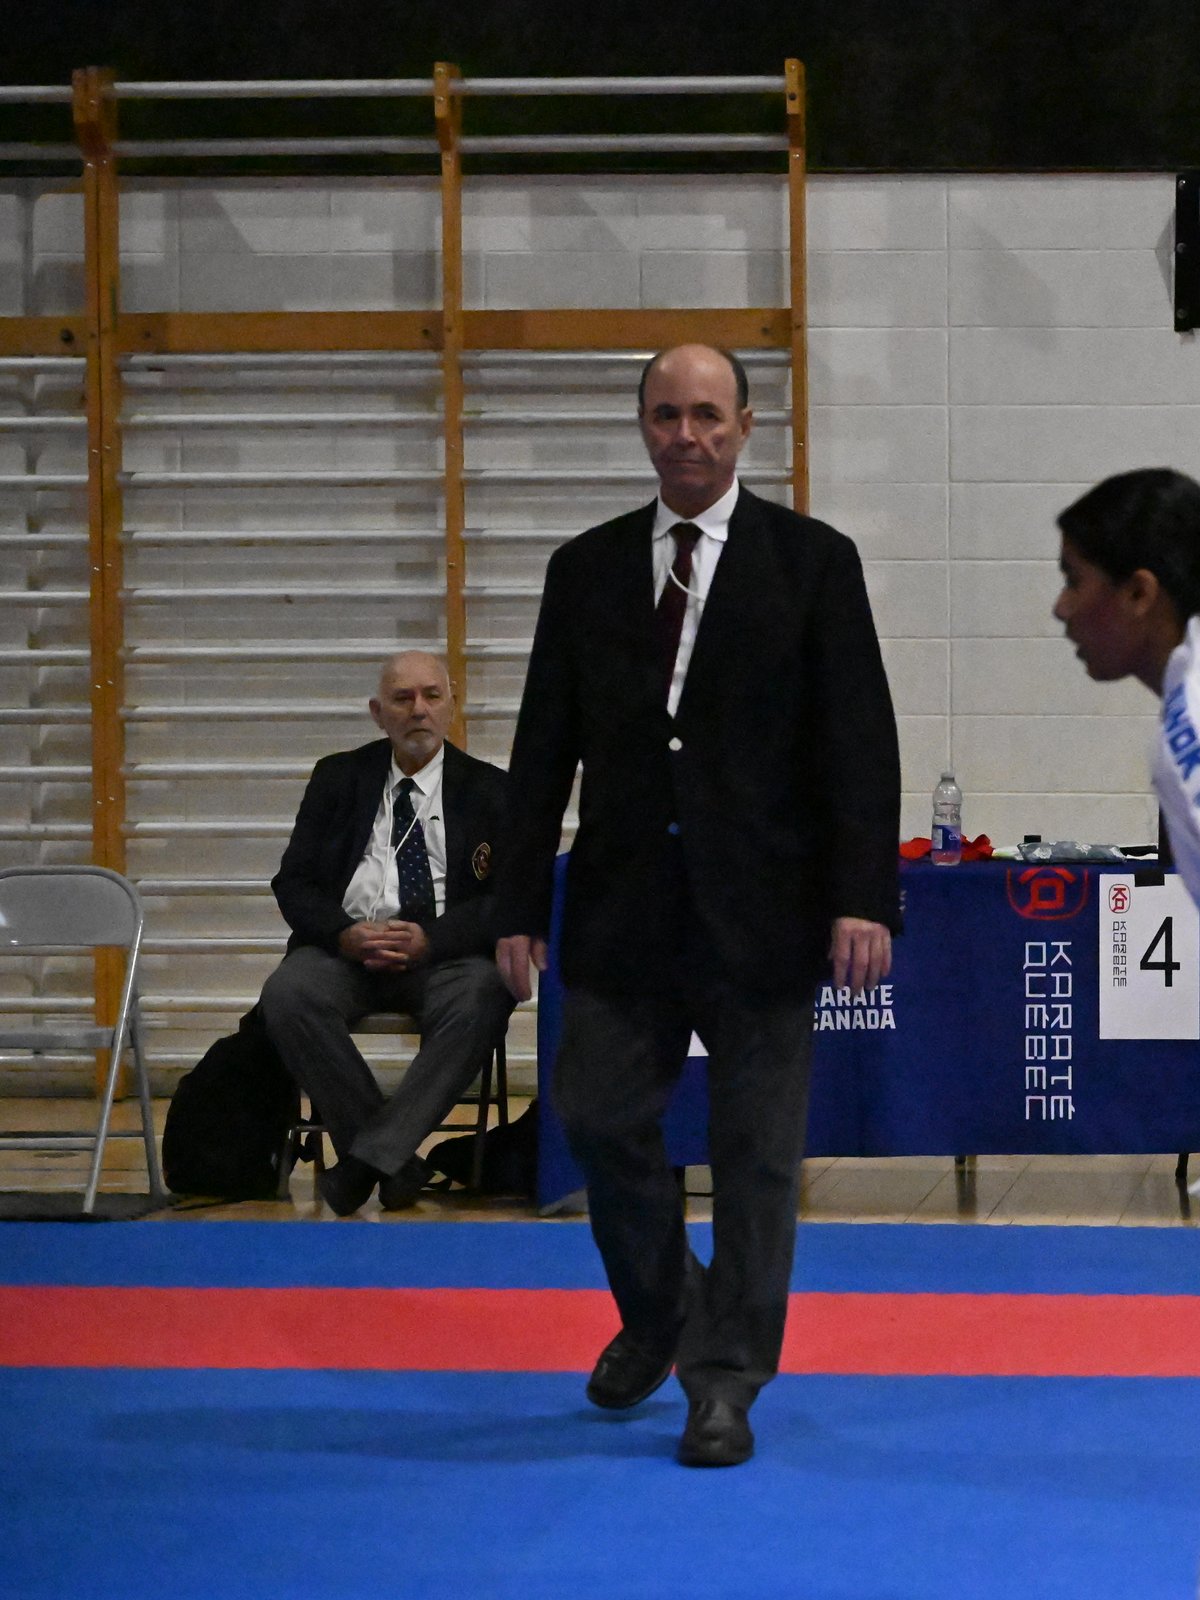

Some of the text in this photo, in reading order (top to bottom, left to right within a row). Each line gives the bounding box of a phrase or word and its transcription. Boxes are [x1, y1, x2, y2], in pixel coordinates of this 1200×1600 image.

[815, 984, 894, 1008] ARATE
[1139, 916, 1181, 988] 4
[1022, 941, 1048, 1121] QUÉBEC
[1050, 941, 1076, 1121] KARATÉ
